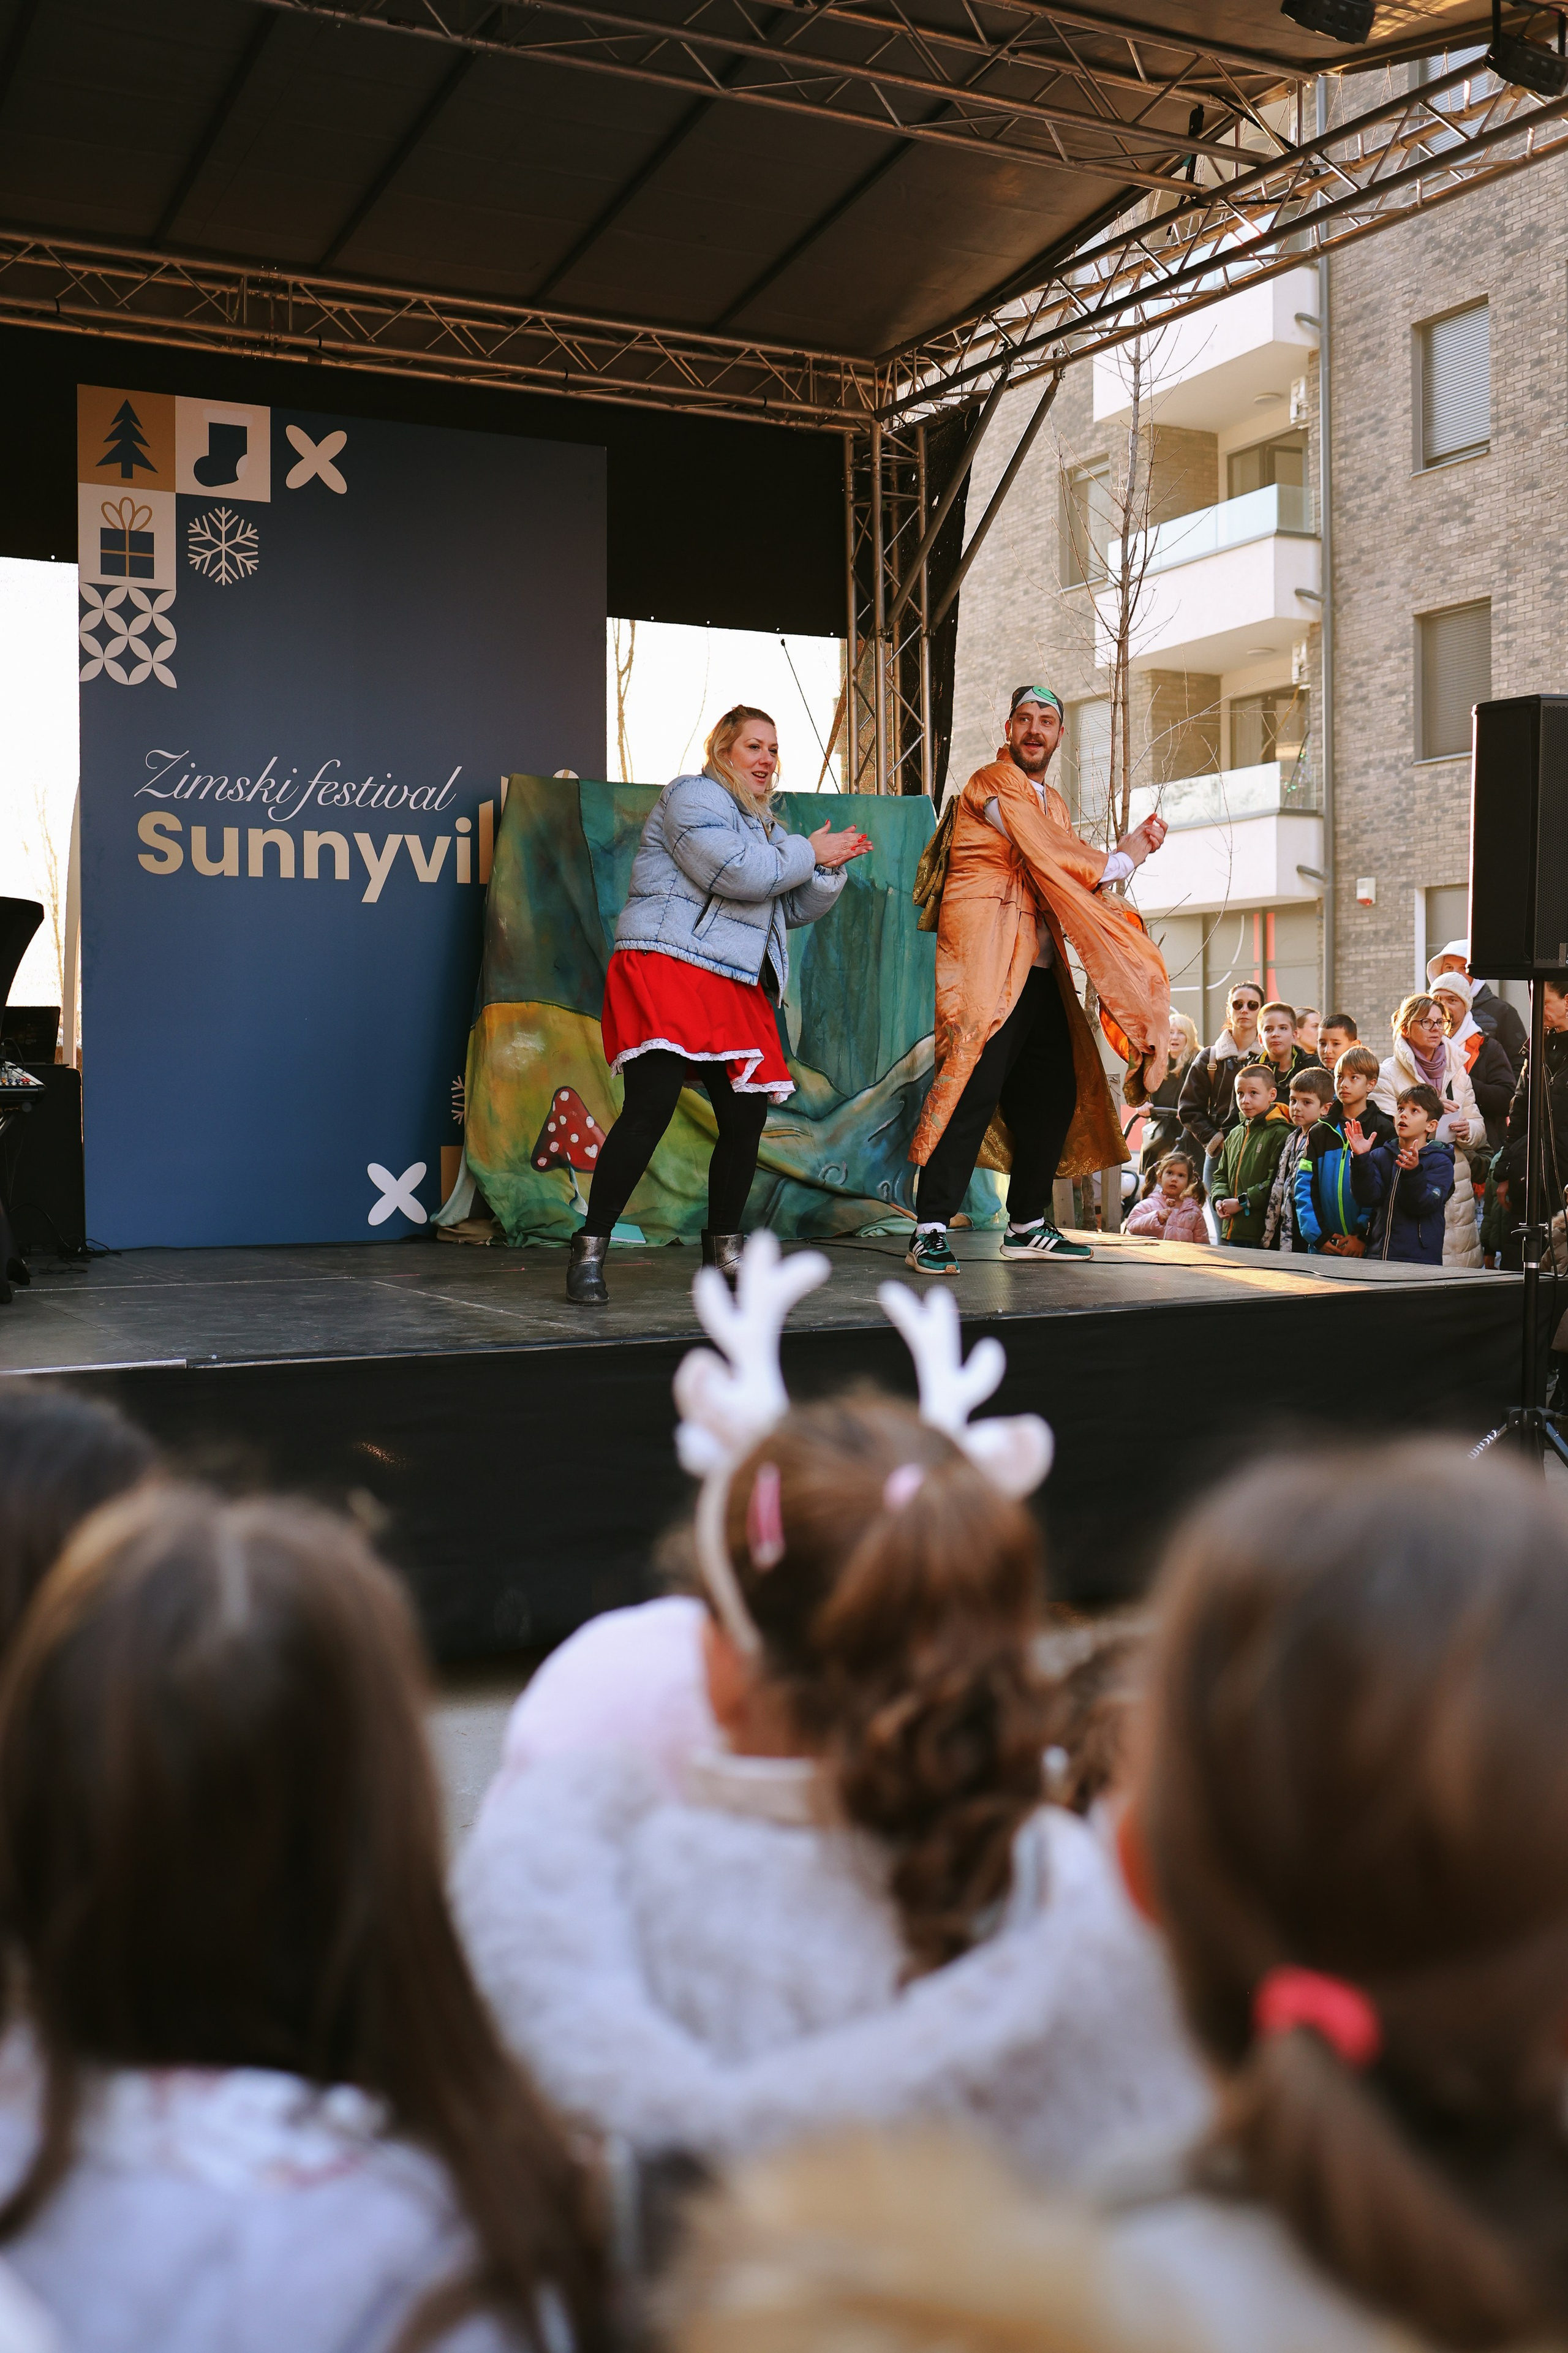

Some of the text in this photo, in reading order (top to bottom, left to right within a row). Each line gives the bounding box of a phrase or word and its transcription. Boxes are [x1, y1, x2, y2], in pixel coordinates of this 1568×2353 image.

[134, 750, 463, 822] Zimski festival
[137, 776, 509, 903] Sunnyvil
